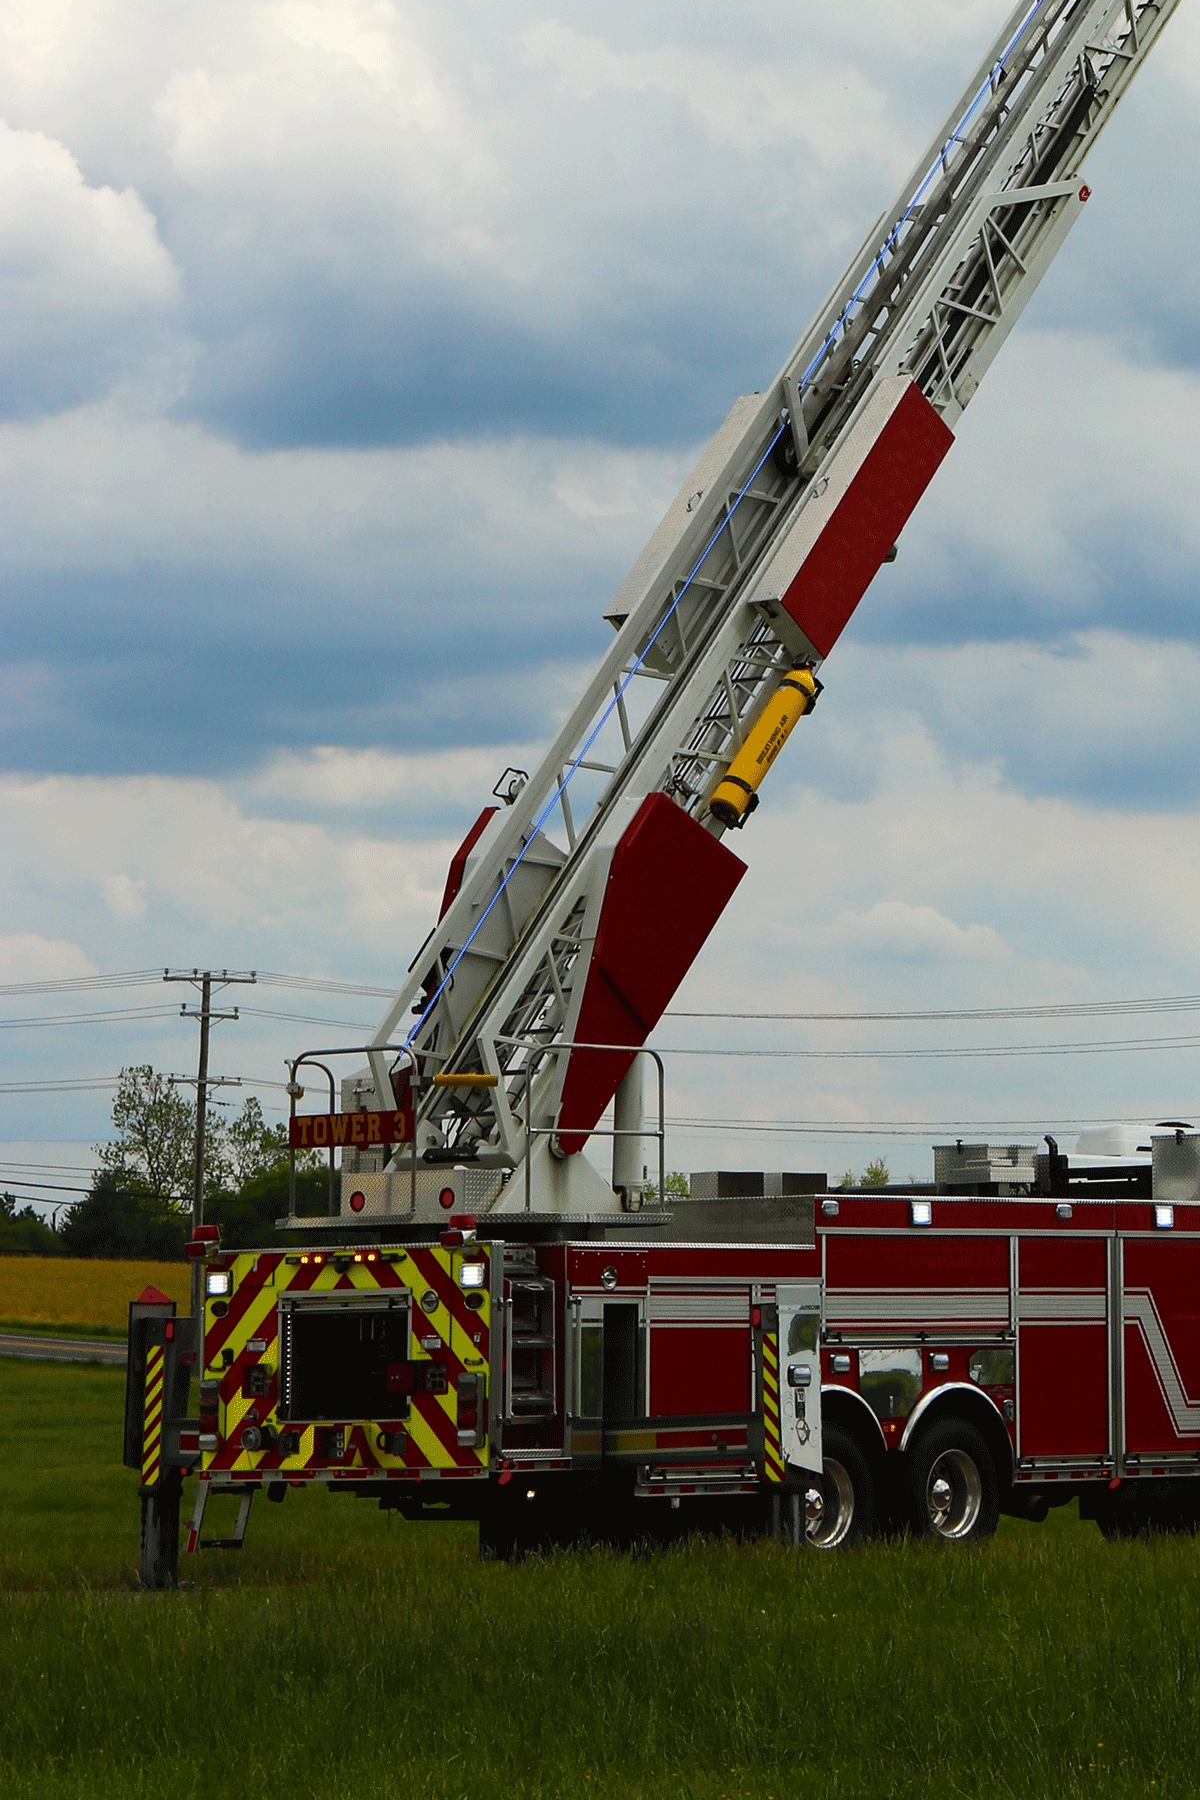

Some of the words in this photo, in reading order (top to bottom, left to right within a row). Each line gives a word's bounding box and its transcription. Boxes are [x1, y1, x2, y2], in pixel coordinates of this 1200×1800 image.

[757, 726, 781, 764] BREATHING
[780, 715, 789, 727] AIR
[298, 1113, 381, 1145] TOWER
[393, 1111, 406, 1141] 3
